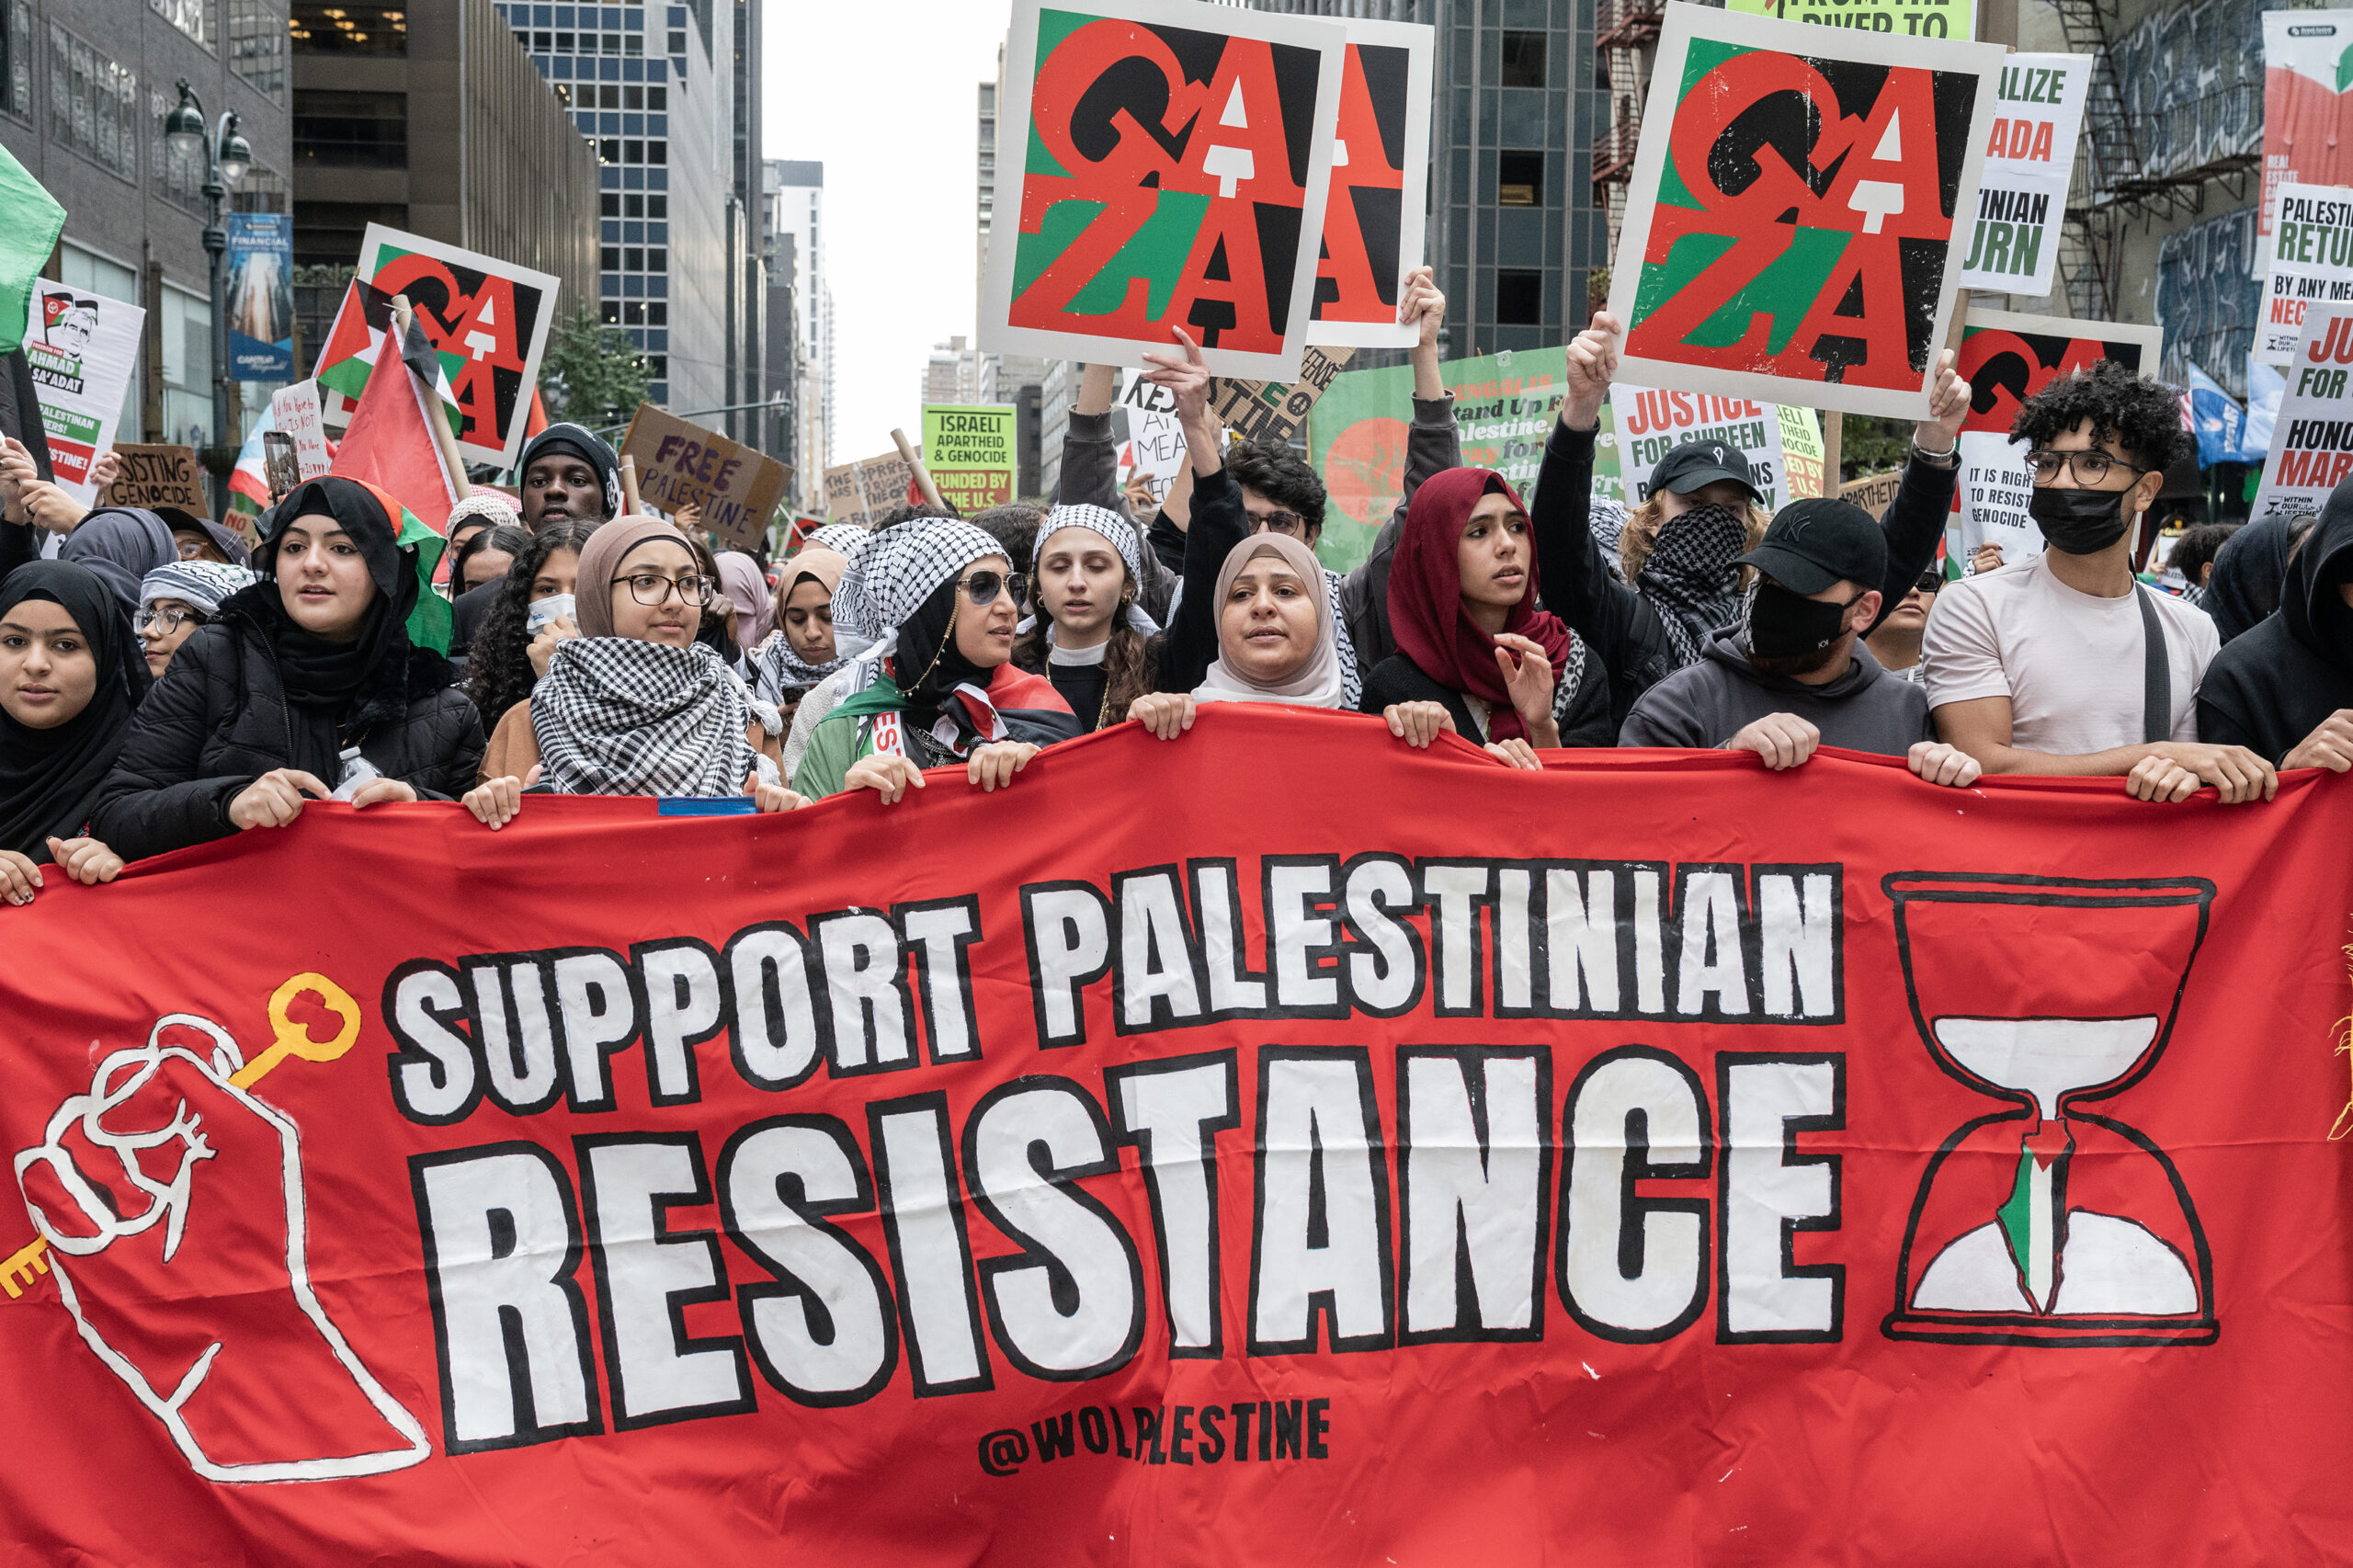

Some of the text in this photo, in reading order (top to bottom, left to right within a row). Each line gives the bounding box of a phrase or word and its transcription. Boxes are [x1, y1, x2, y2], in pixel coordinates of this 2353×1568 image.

[2268, 154, 2289, 168] REAL
[1979, 188, 2050, 225] INIAN
[2282, 197, 2353, 228] PALESTI
[232, 235, 289, 246] FINANCIAL
[2275, 276, 2353, 301] BY ANY ME
[28, 350, 75, 374] AHMAD
[1444, 375, 1553, 402] ENGALIS
[2296, 368, 2348, 399] FOR
[1452, 399, 1505, 421] tand
[1510, 398, 1542, 418] Up
[301, 415, 314, 429] NOT
[940, 415, 1001, 433] ISRAELI
[937, 435, 1005, 448] APARTHEID
[1461, 439, 1545, 465] ray for
[1631, 436, 1673, 467] FOR
[655, 435, 743, 492] FREE
[934, 449, 1007, 463] & GENOCIDE
[118, 453, 189, 483] SISTING
[1805, 460, 1824, 480] BY
[1970, 468, 1981, 482] IT
[1984, 469, 1996, 483] IS
[2001, 471, 2030, 488] RIGH
[825, 472, 851, 489] THE
[829, 486, 851, 499] HAS
[873, 473, 911, 490] RIGHTS
[932, 472, 1008, 489] FUNDED BY
[111, 483, 196, 506] GENOCIDE
[640, 468, 756, 535] PALESTINE
[865, 488, 889, 506] THE
[942, 492, 999, 507] THE U.S.
[1971, 488, 2032, 509] TO RESIST
[224, 513, 247, 531] NO
[1972, 508, 2028, 528] GENOCIDE
[381, 851, 1846, 1126] SUPPORT PALESTINIAN
[406, 1043, 1846, 1457] RESISTANCE
[978, 1397, 1331, 1477] @WOLPLESTINE
